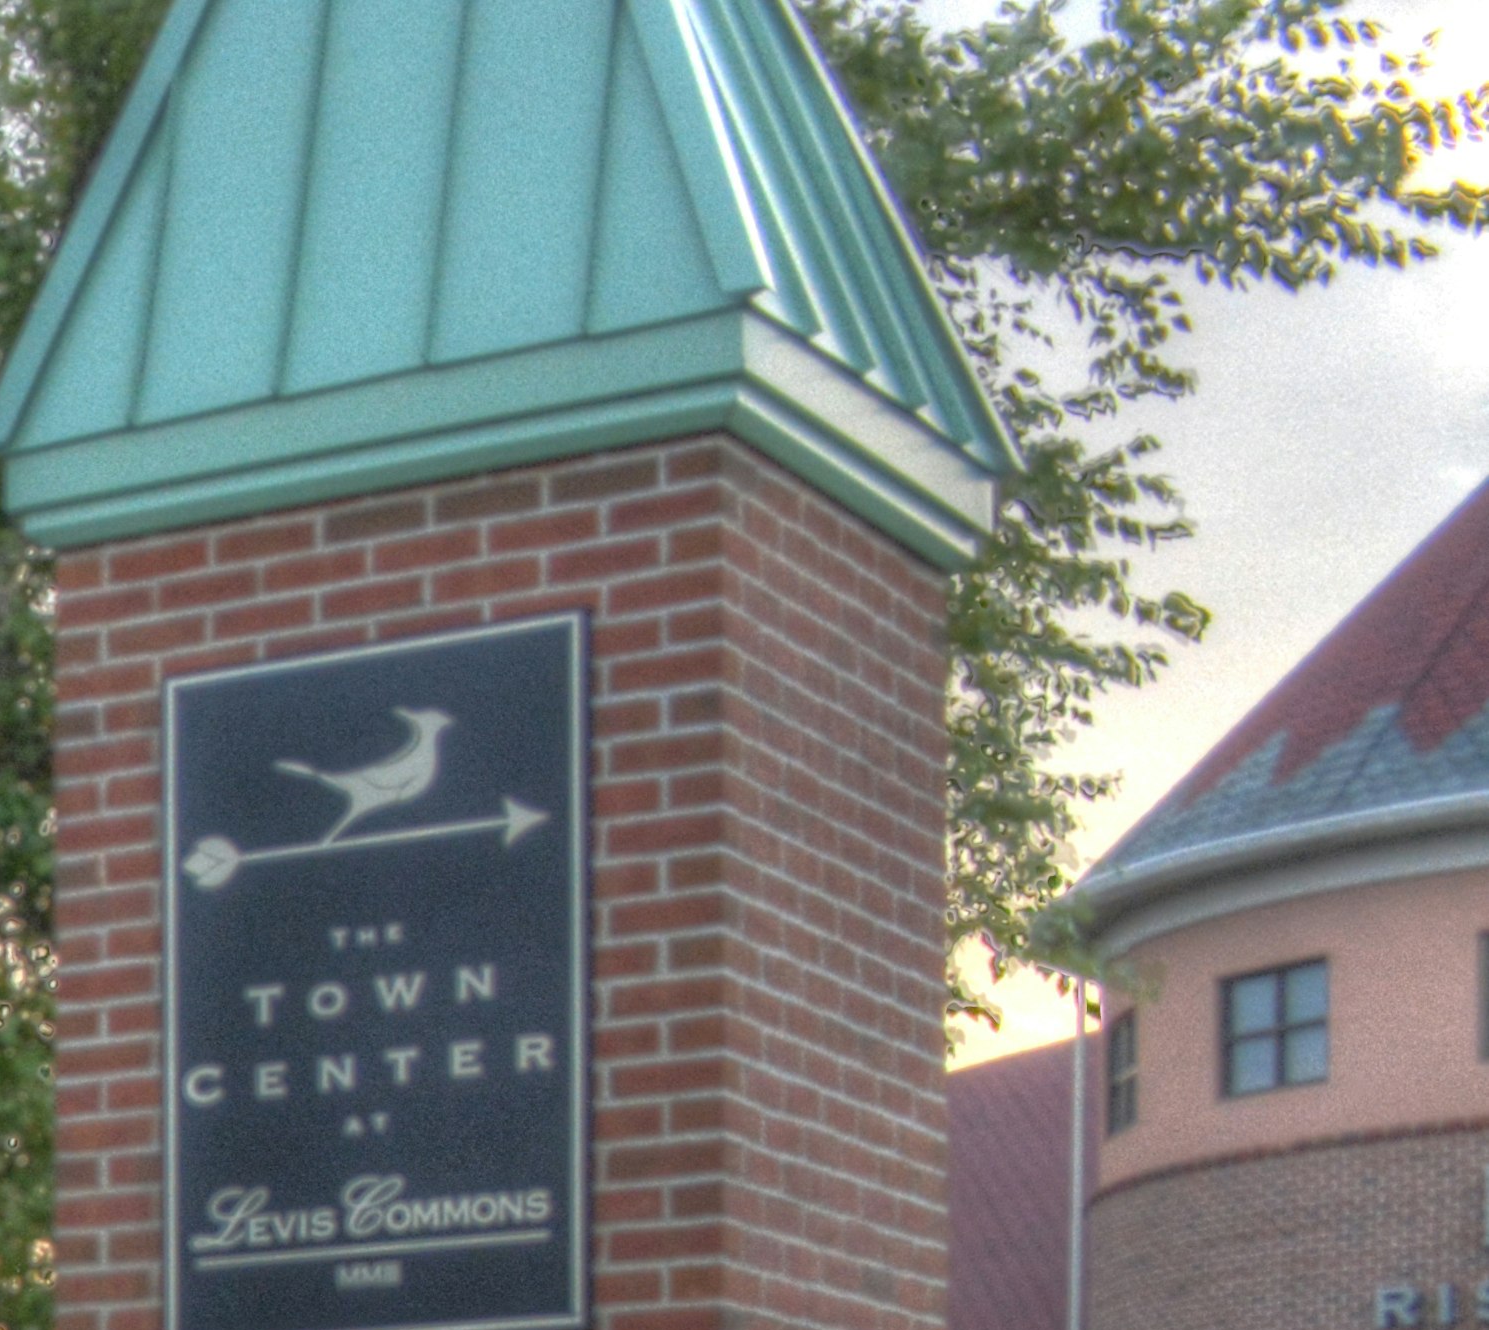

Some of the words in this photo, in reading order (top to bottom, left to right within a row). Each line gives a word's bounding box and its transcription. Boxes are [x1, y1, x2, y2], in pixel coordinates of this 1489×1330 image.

[333, 922, 405, 948] THE
[247, 963, 495, 1028] TOWN
[184, 1034, 555, 1104] CENTER
[343, 1112, 390, 1137] AT
[189, 1187, 336, 1247] LEVIS
[340, 1173, 551, 1237] COMMONS
